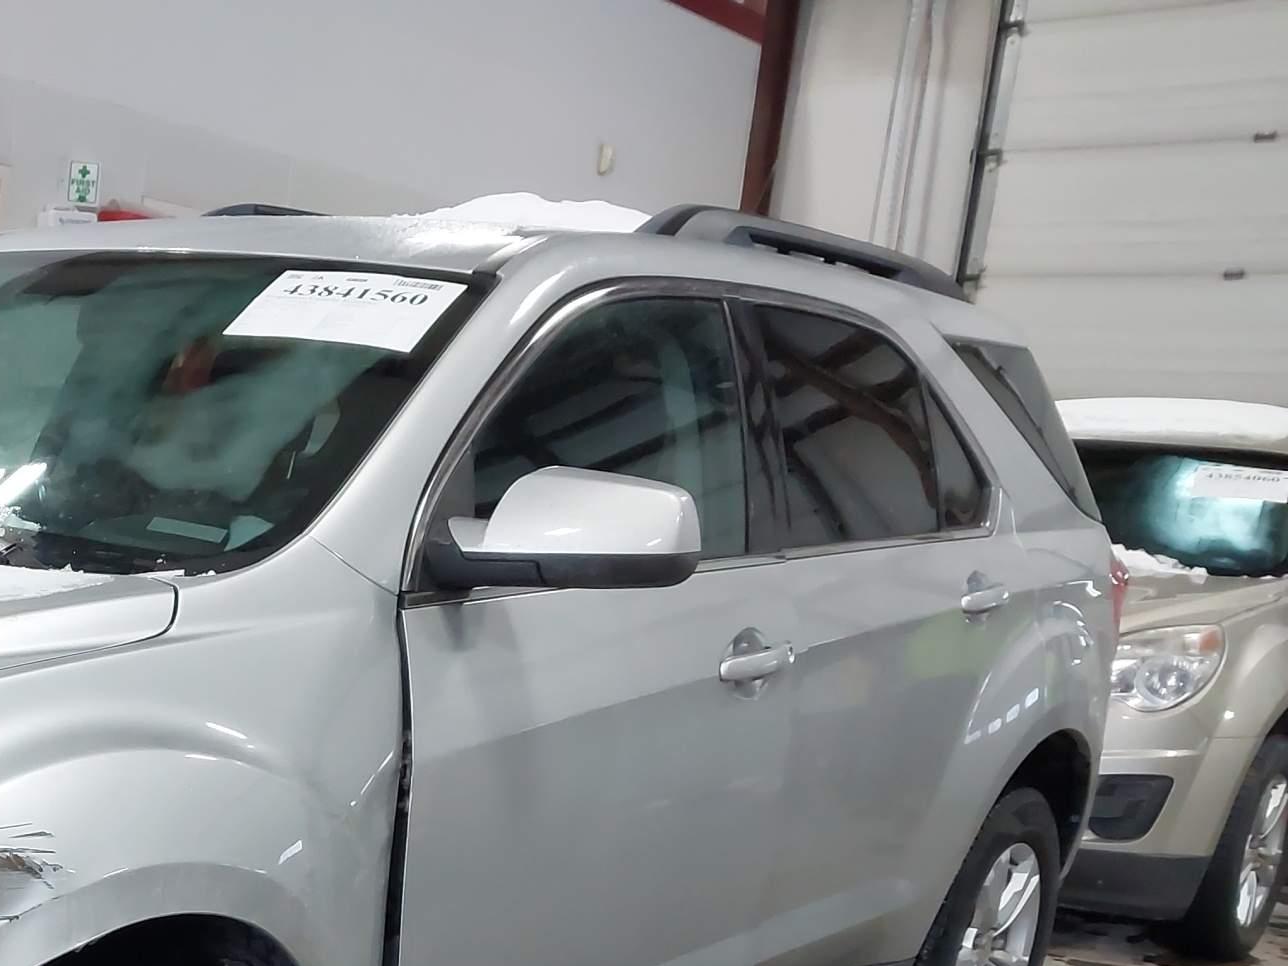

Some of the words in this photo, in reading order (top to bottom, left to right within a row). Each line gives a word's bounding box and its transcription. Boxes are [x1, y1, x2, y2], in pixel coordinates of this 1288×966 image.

[71, 178, 95, 187] FIRST
[75, 186, 91, 195] AID
[283, 284, 428, 305] 43841560
